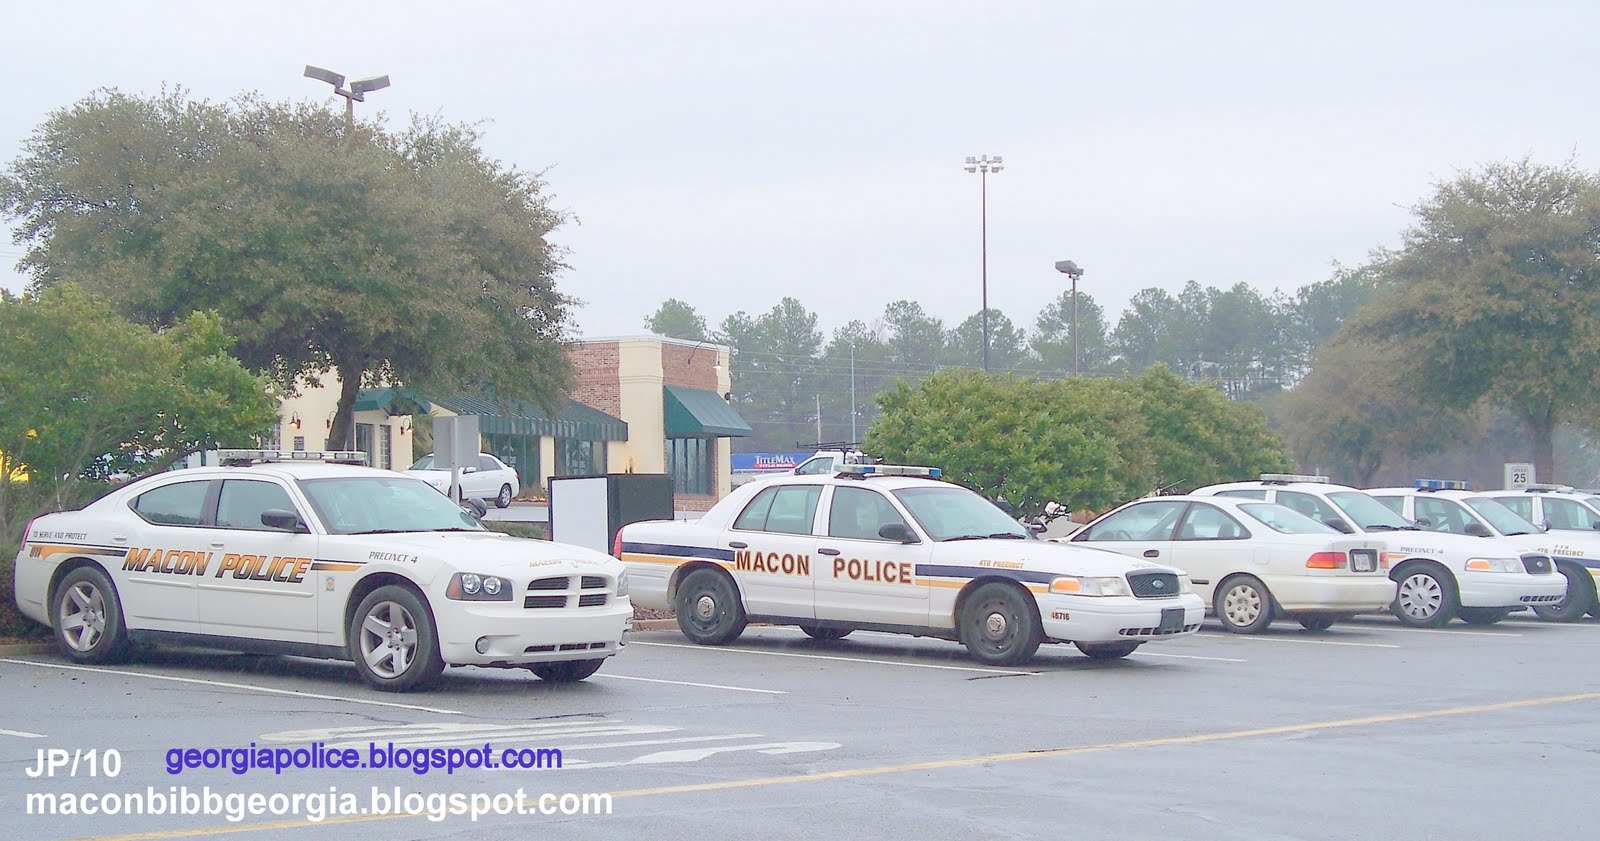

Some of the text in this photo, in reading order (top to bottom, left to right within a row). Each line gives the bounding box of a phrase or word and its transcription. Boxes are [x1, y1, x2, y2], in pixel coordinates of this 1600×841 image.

[1513, 473, 1526, 483] 25
[65, 532, 87, 540] PROTECT
[1400, 546, 1436, 554] PRECINCT
[1553, 549, 1584, 557] PRECINCT
[368, 551, 419, 564] PRECINCT 4
[122, 547, 312, 583] MACON POLICE
[735, 550, 913, 584] MACON POLICE
[992, 560, 1024, 569] PRECINCT
